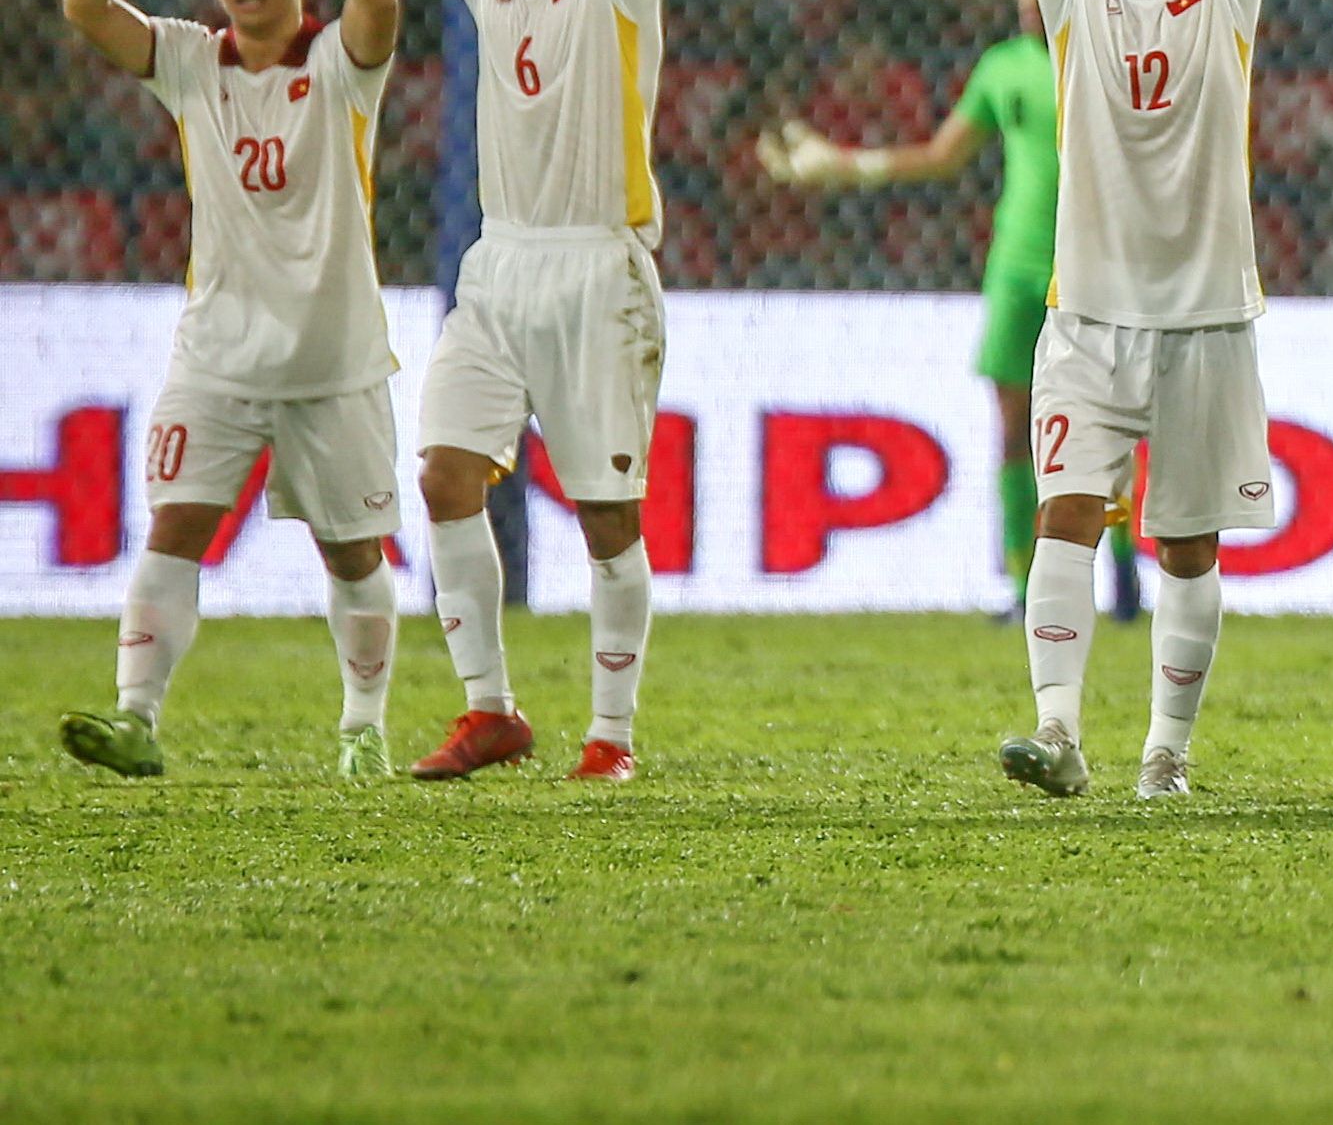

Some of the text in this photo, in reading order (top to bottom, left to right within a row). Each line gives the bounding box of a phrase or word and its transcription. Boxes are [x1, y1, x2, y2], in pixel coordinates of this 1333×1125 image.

[516, 37, 542, 97] 6
[1125, 50, 1172, 111] 12
[234, 136, 288, 192] 20
[1035, 413, 1070, 477] 12
